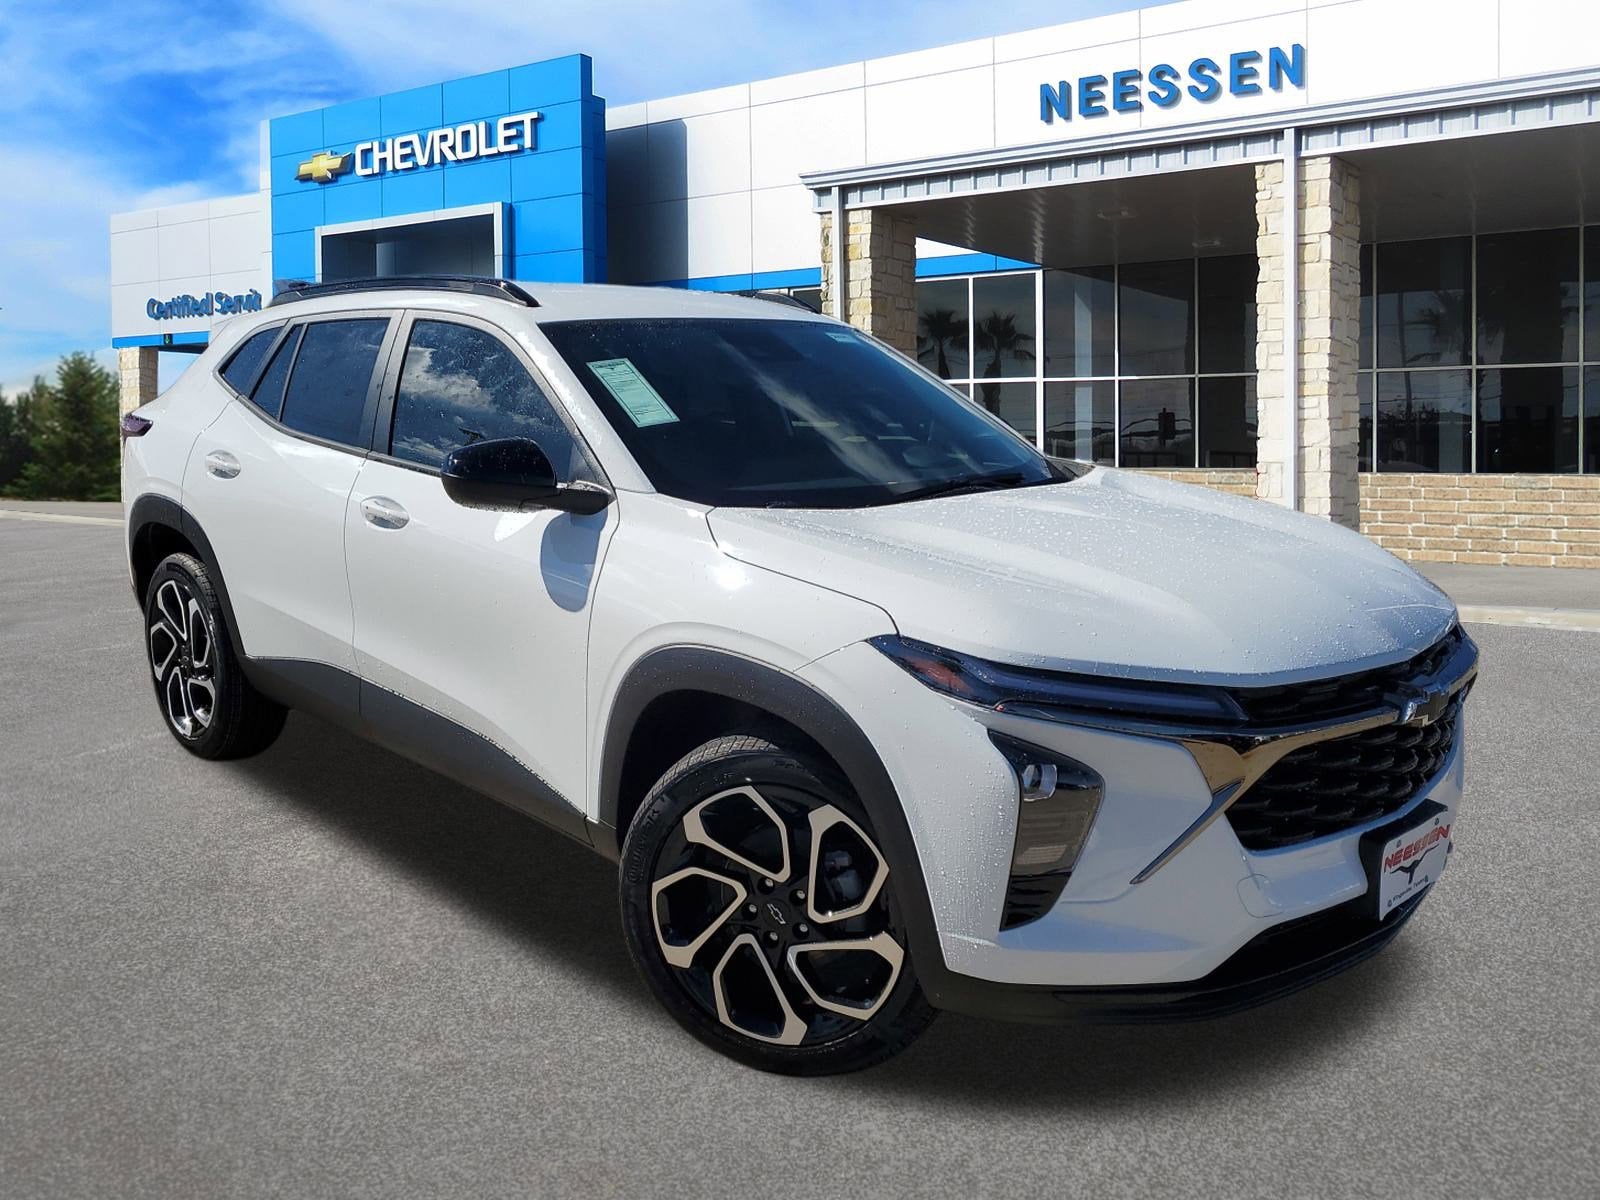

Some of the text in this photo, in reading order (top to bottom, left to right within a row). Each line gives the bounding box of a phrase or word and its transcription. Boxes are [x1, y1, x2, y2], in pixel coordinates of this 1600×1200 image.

[1039, 43, 1306, 125] NEESSEN
[354, 111, 543, 177] CHEVROLET
[146, 288, 262, 320] Certified Servi
